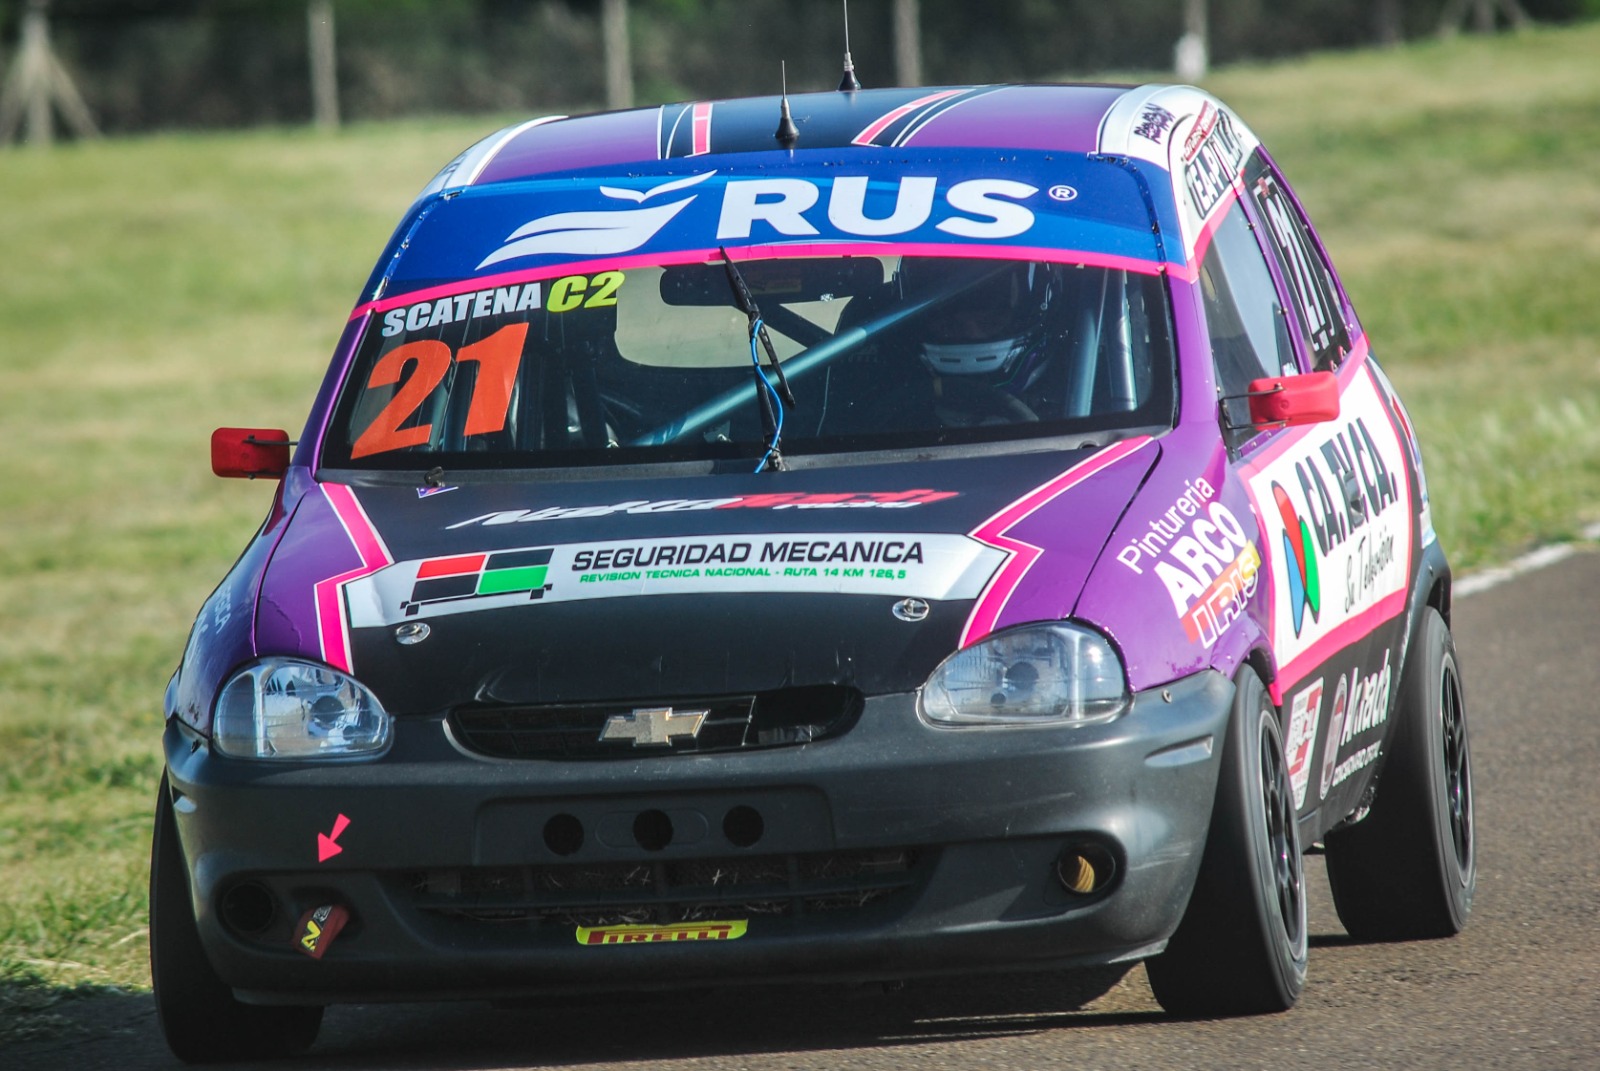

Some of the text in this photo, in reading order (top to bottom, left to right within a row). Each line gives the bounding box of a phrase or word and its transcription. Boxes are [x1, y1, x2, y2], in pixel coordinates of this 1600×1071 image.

[716, 176, 1039, 239] RUS
[382, 271, 625, 337] SCATENA C2
[351, 322, 529, 460] 21
[572, 541, 924, 571] SEGURIDAD MECANICA
[1116, 477, 1216, 575] Pinturería
[580, 571, 641, 583] REVISION
[645, 569, 700, 579] TECNICA
[704, 567, 771, 577] NACIONAL
[783, 568, 818, 577] RUTA
[823, 568, 839, 577] 14
[842, 568, 864, 577] KM
[1154, 501, 1247, 619] ARCO
[1192, 552, 1258, 649] IRIS
[587, 924, 733, 944] PIRELLI
